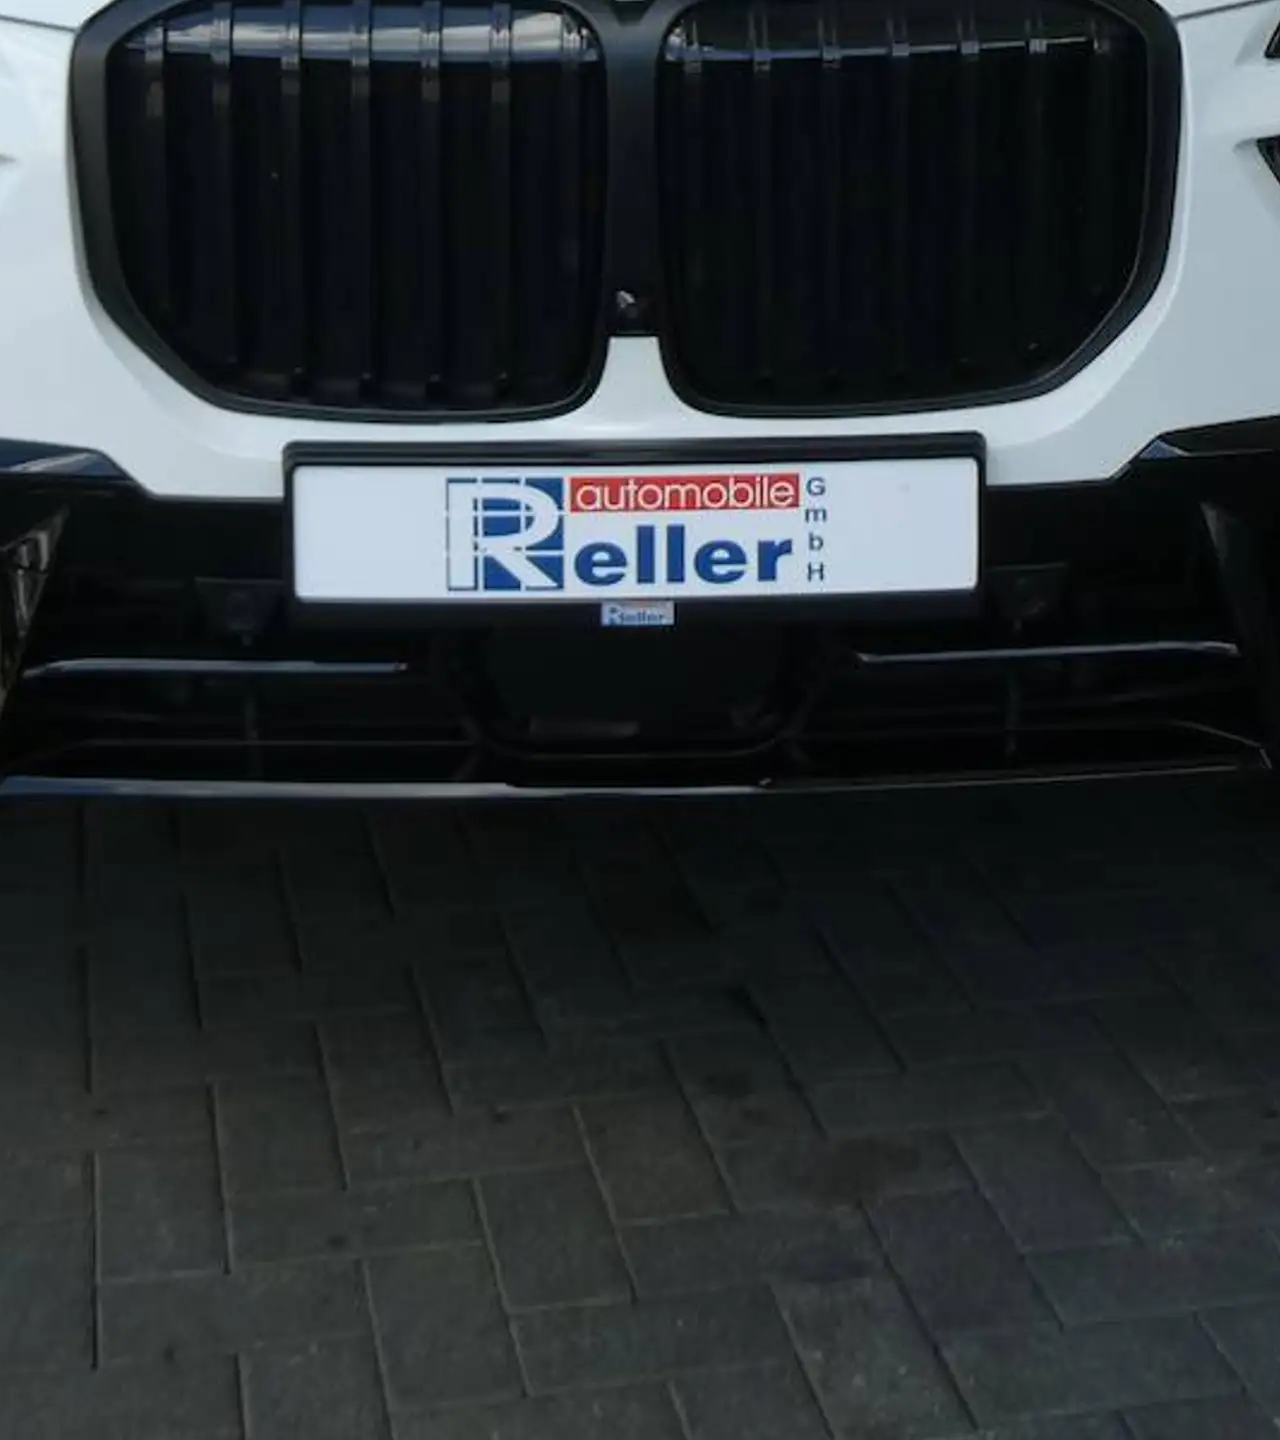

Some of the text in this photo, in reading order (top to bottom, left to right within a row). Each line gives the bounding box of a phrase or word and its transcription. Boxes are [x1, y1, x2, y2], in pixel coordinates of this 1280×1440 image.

[447, 477, 793, 591] Reller
[576, 477, 795, 510] automobile
[804, 477, 827, 582] GmbH
